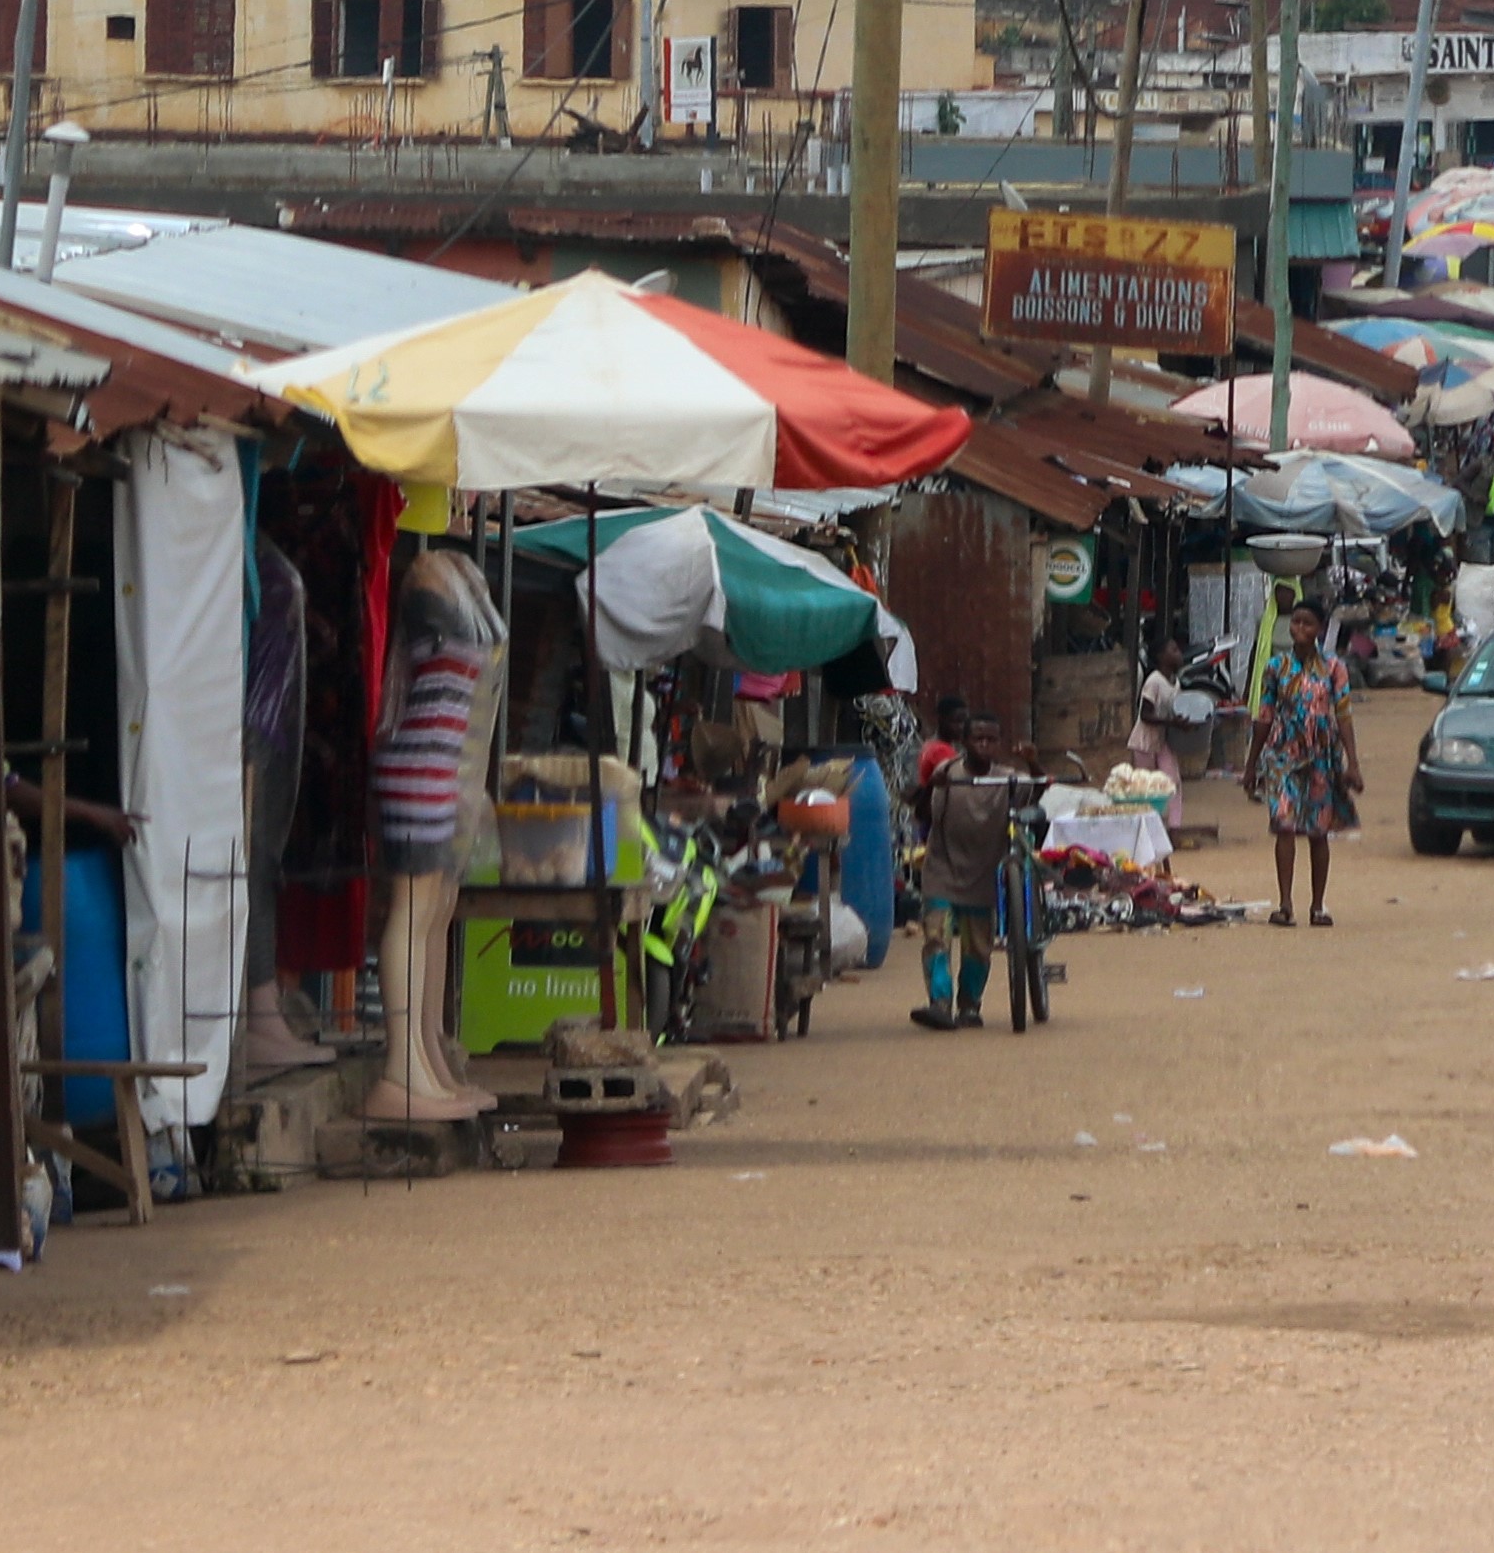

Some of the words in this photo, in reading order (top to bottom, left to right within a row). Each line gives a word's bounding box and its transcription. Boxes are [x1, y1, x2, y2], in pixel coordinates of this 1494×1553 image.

[1029, 268, 1209, 308] ALIMENTATIONS
[1012, 294, 1103, 327] BOISSONS
[1135, 303, 1203, 334] DIVERS
[508, 978, 537, 998] no
